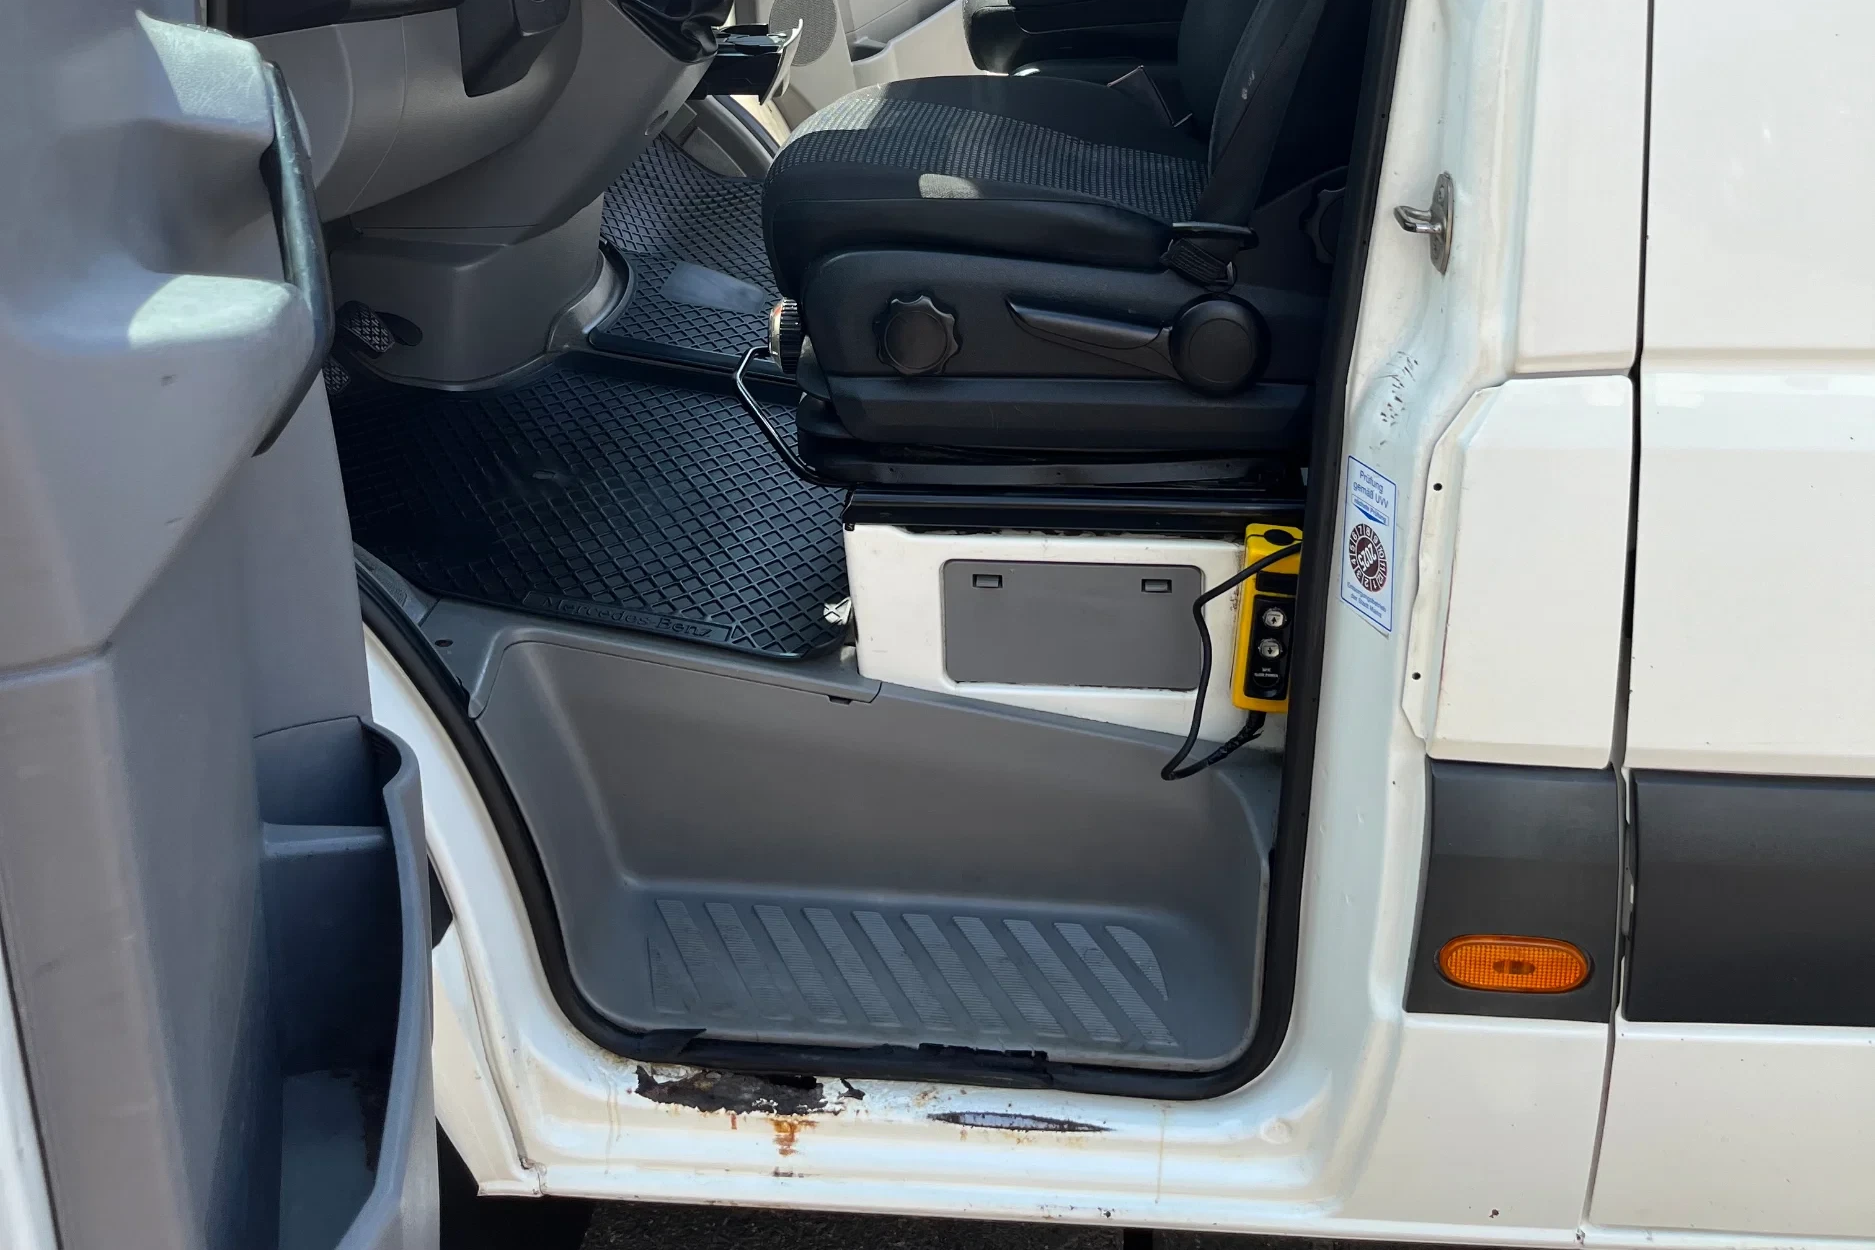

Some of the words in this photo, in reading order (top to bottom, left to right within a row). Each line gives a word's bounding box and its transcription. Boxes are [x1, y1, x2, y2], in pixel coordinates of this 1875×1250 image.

[1353, 481, 1374, 500] gemäß
[1375, 493, 1388, 509] UVV
[1360, 469, 1384, 494] Prüfung
[1357, 542, 1377, 572] 2025
[542, 596, 712, 638] Mercedes-Benz
